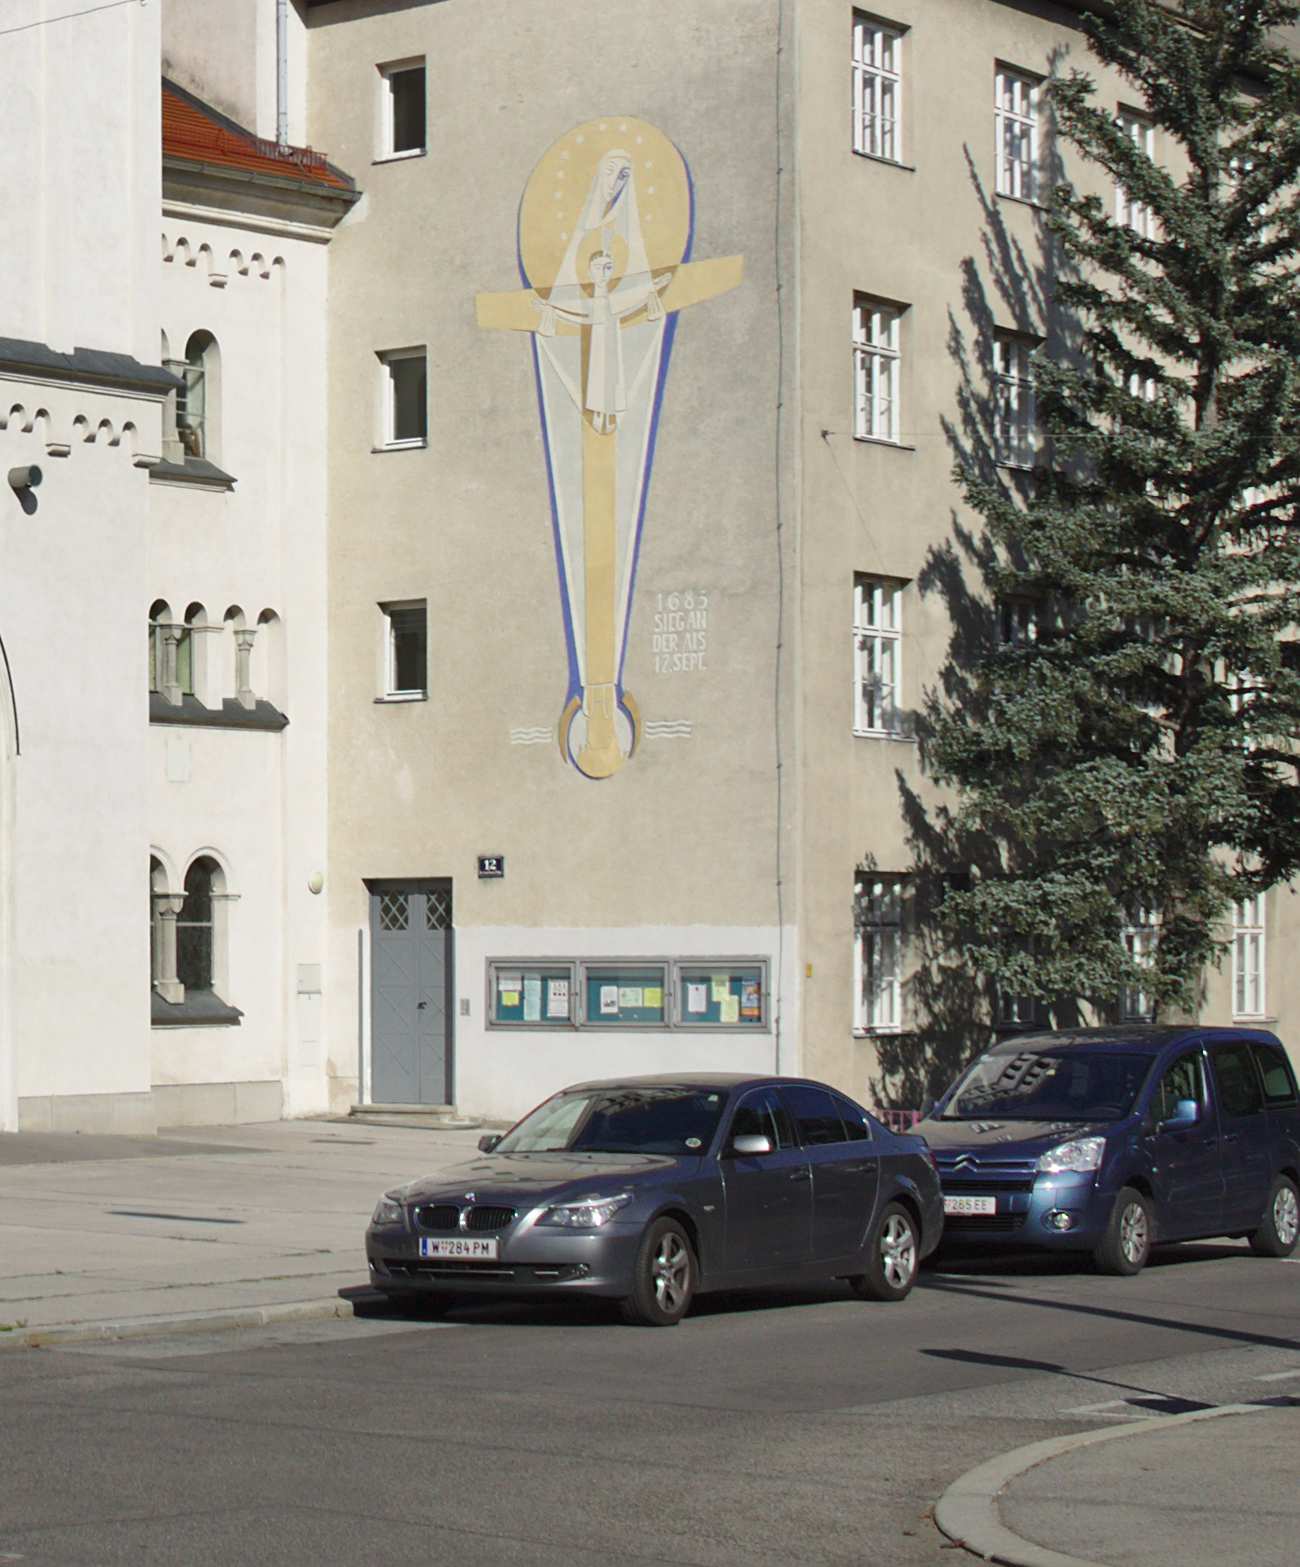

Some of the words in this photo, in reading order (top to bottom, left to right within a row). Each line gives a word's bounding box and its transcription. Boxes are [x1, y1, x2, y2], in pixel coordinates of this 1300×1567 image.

[655, 589, 708, 611] 1683
[654, 611, 685, 632] SIEG
[686, 610, 707, 630] AN
[653, 633, 678, 653] DER
[484, 859, 497, 871] 12
[431, 1240, 439, 1253] W
[473, 1241, 490, 1255] PM
